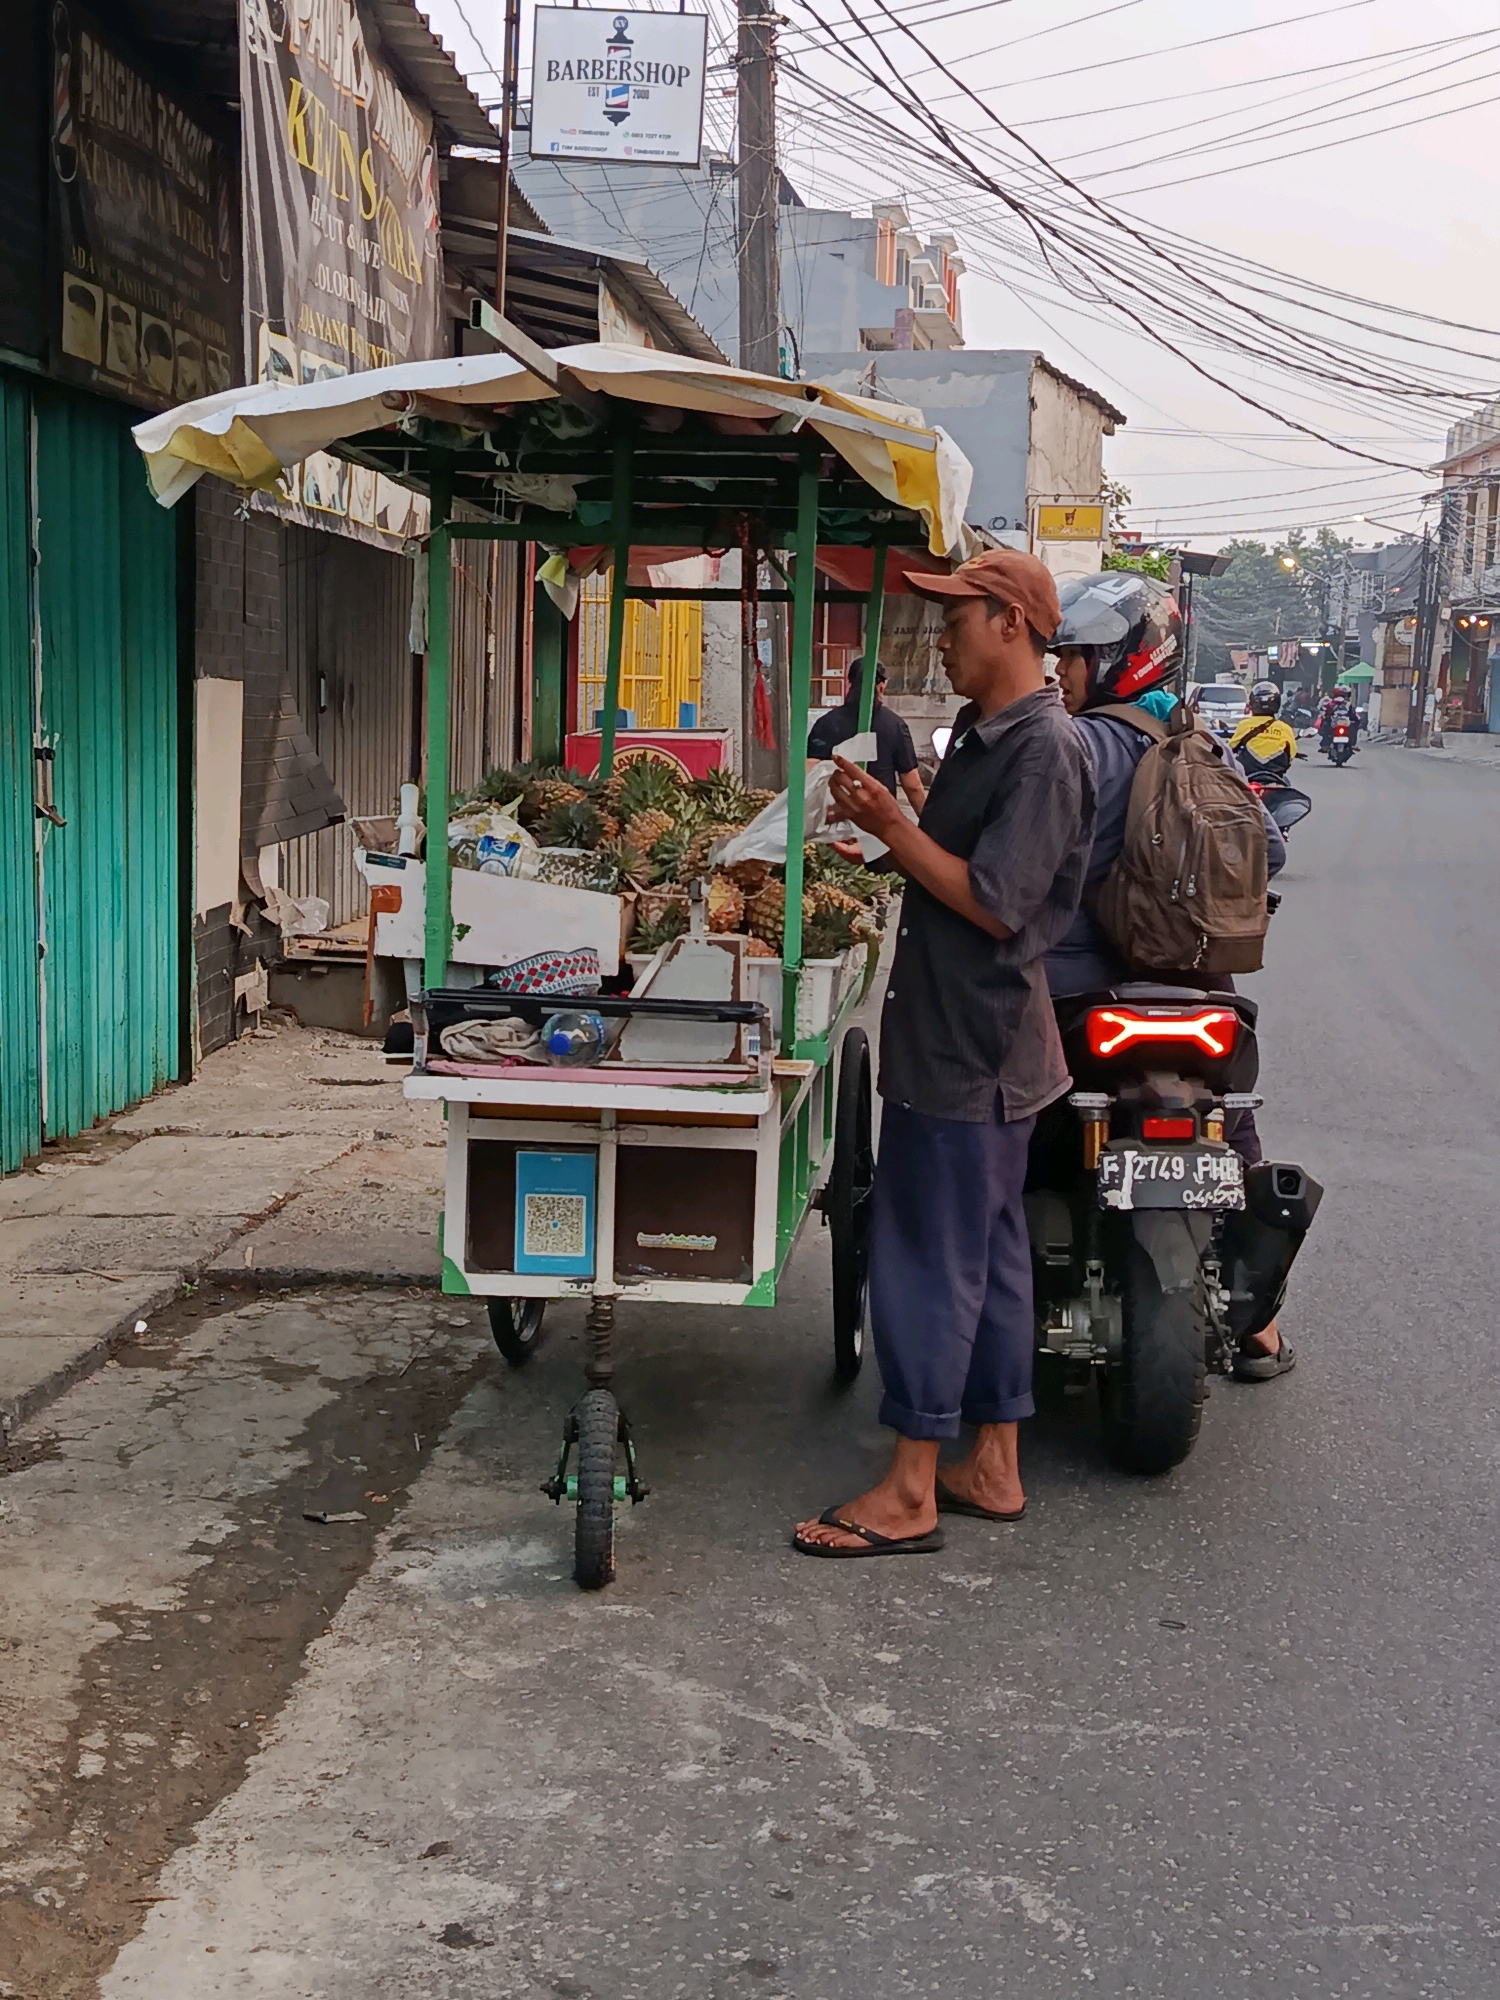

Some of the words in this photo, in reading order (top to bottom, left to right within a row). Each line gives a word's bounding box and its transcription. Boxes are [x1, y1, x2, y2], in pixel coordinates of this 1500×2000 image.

[546, 59, 691, 88] BARBERSHOP
[587, 86, 600, 98] EST
[1102, 1154, 1120, 1181] F
[1132, 1155, 1186, 1181] 2749
